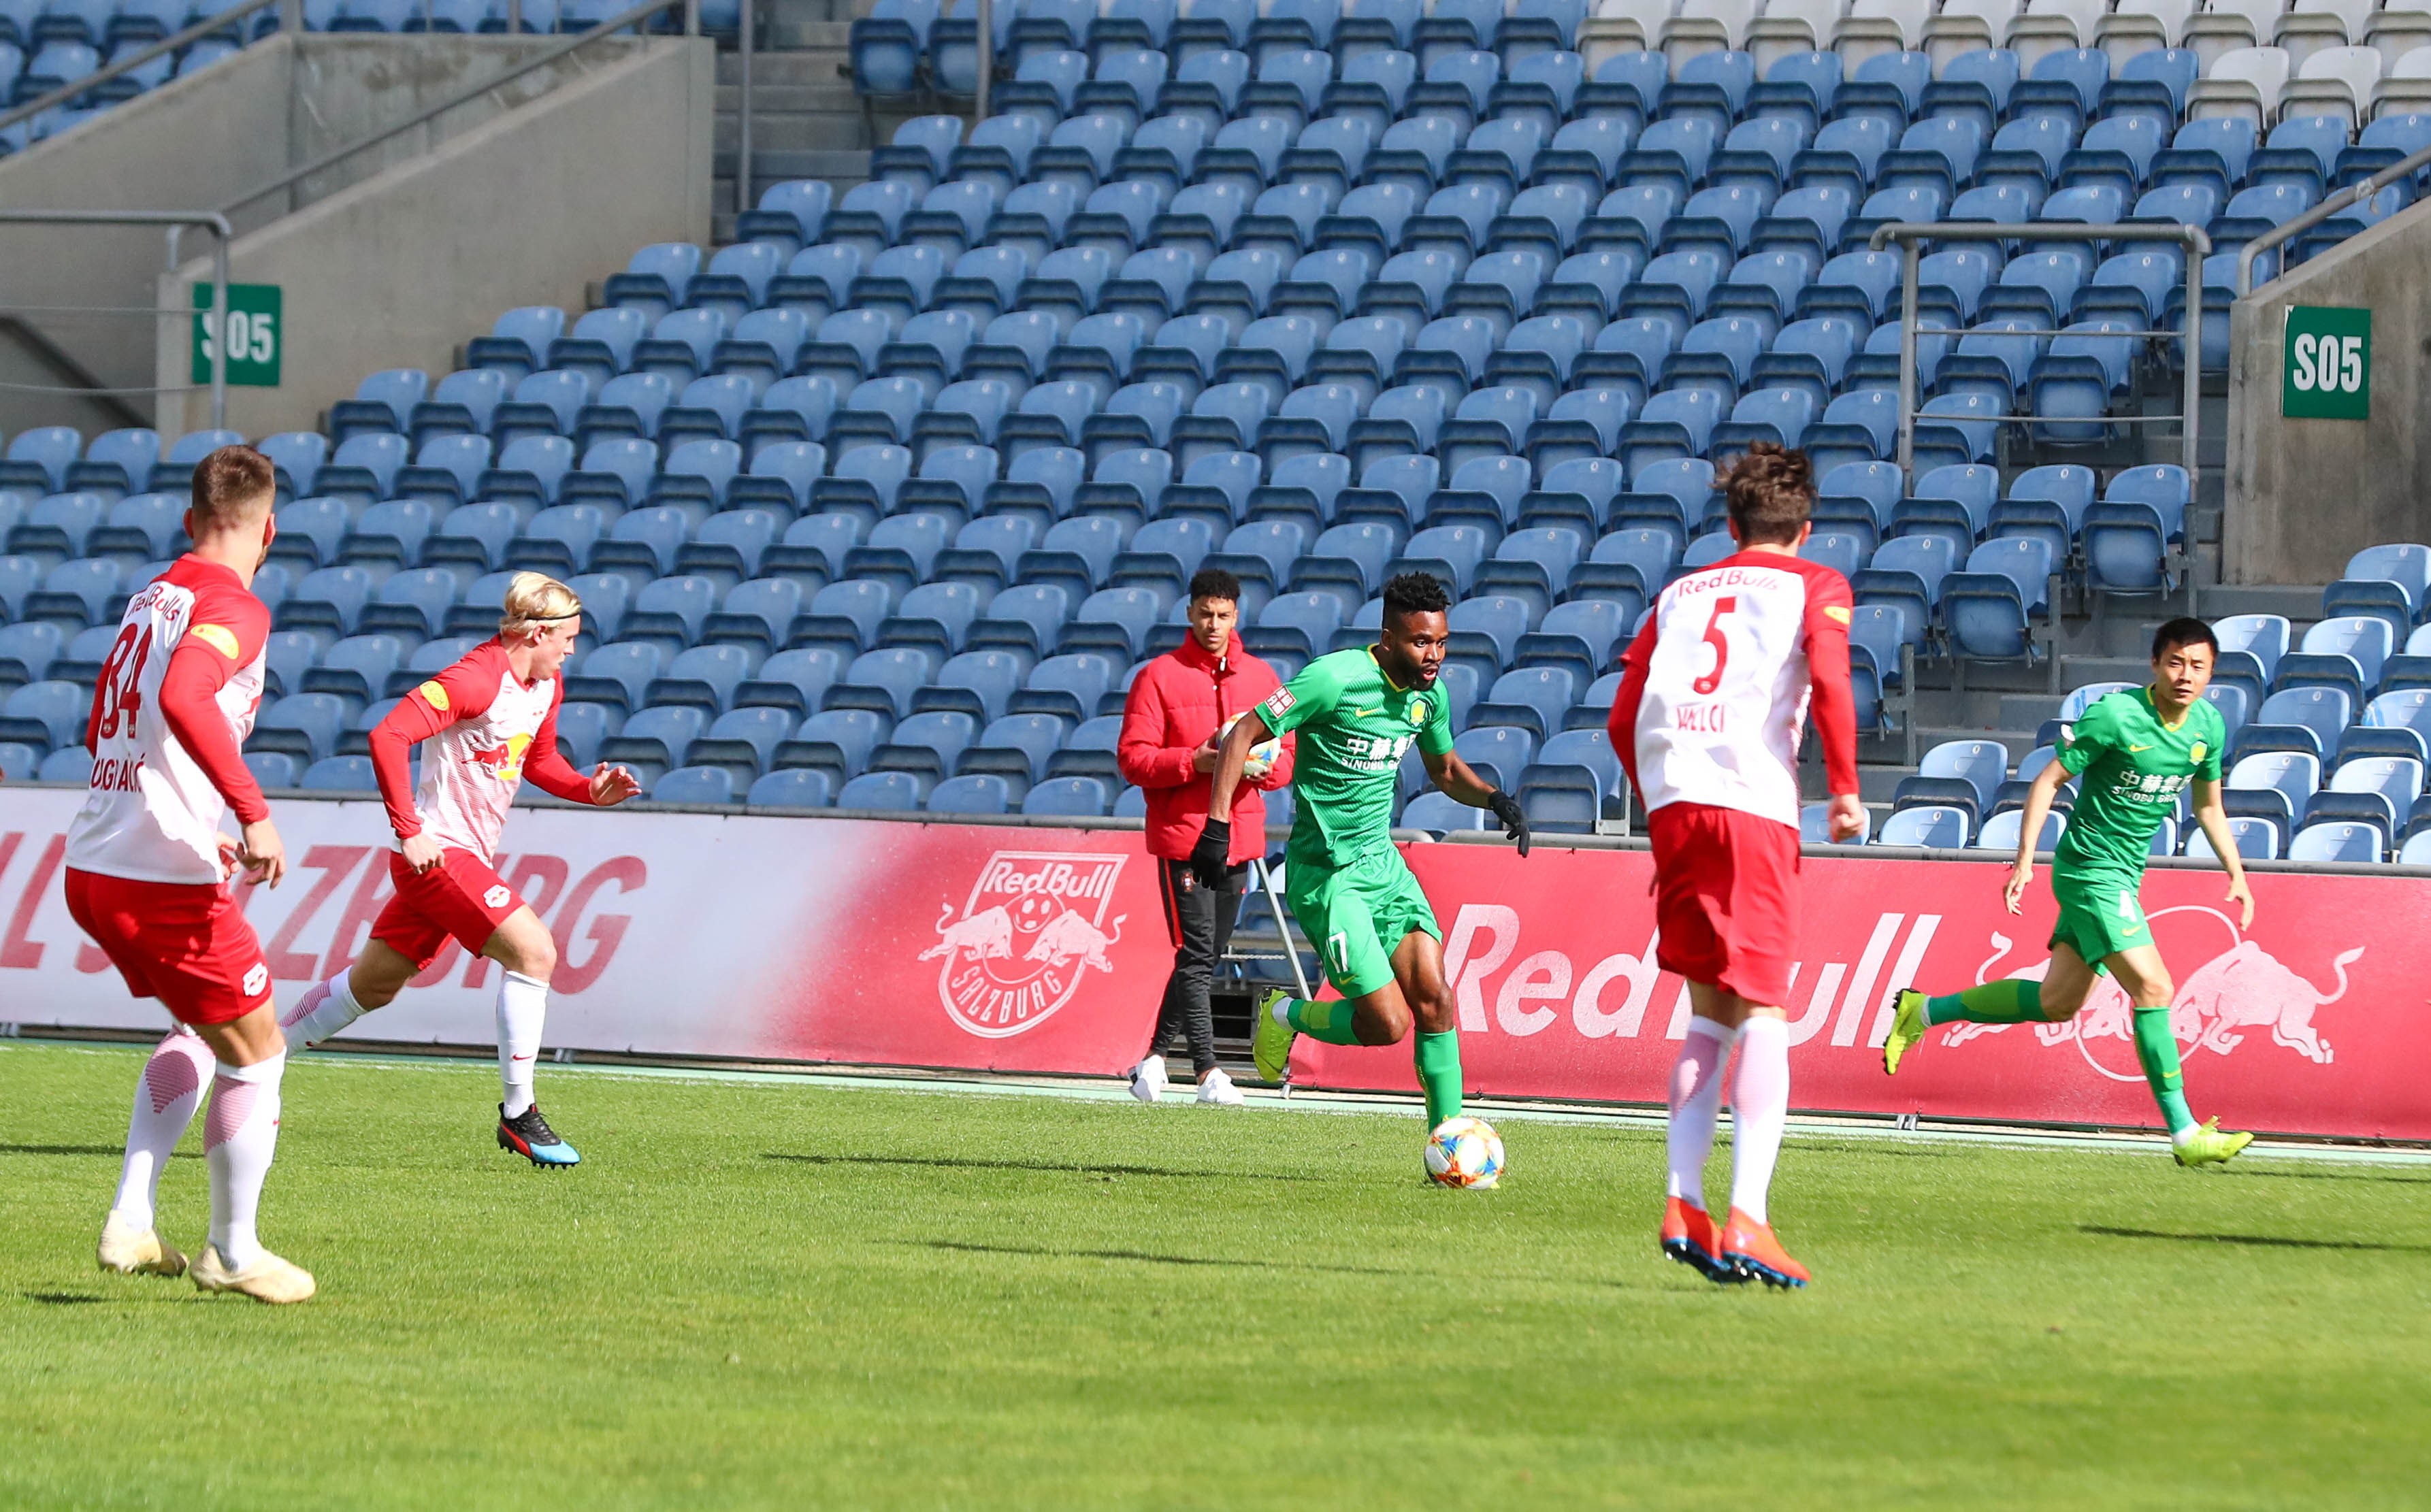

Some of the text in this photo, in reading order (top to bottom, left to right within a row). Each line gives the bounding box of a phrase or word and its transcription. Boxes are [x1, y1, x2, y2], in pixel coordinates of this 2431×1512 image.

[2293, 332, 2362, 393] S05
[1693, 596, 1737, 695] 5
[951, 966, 1062, 1024] SALZBURG
